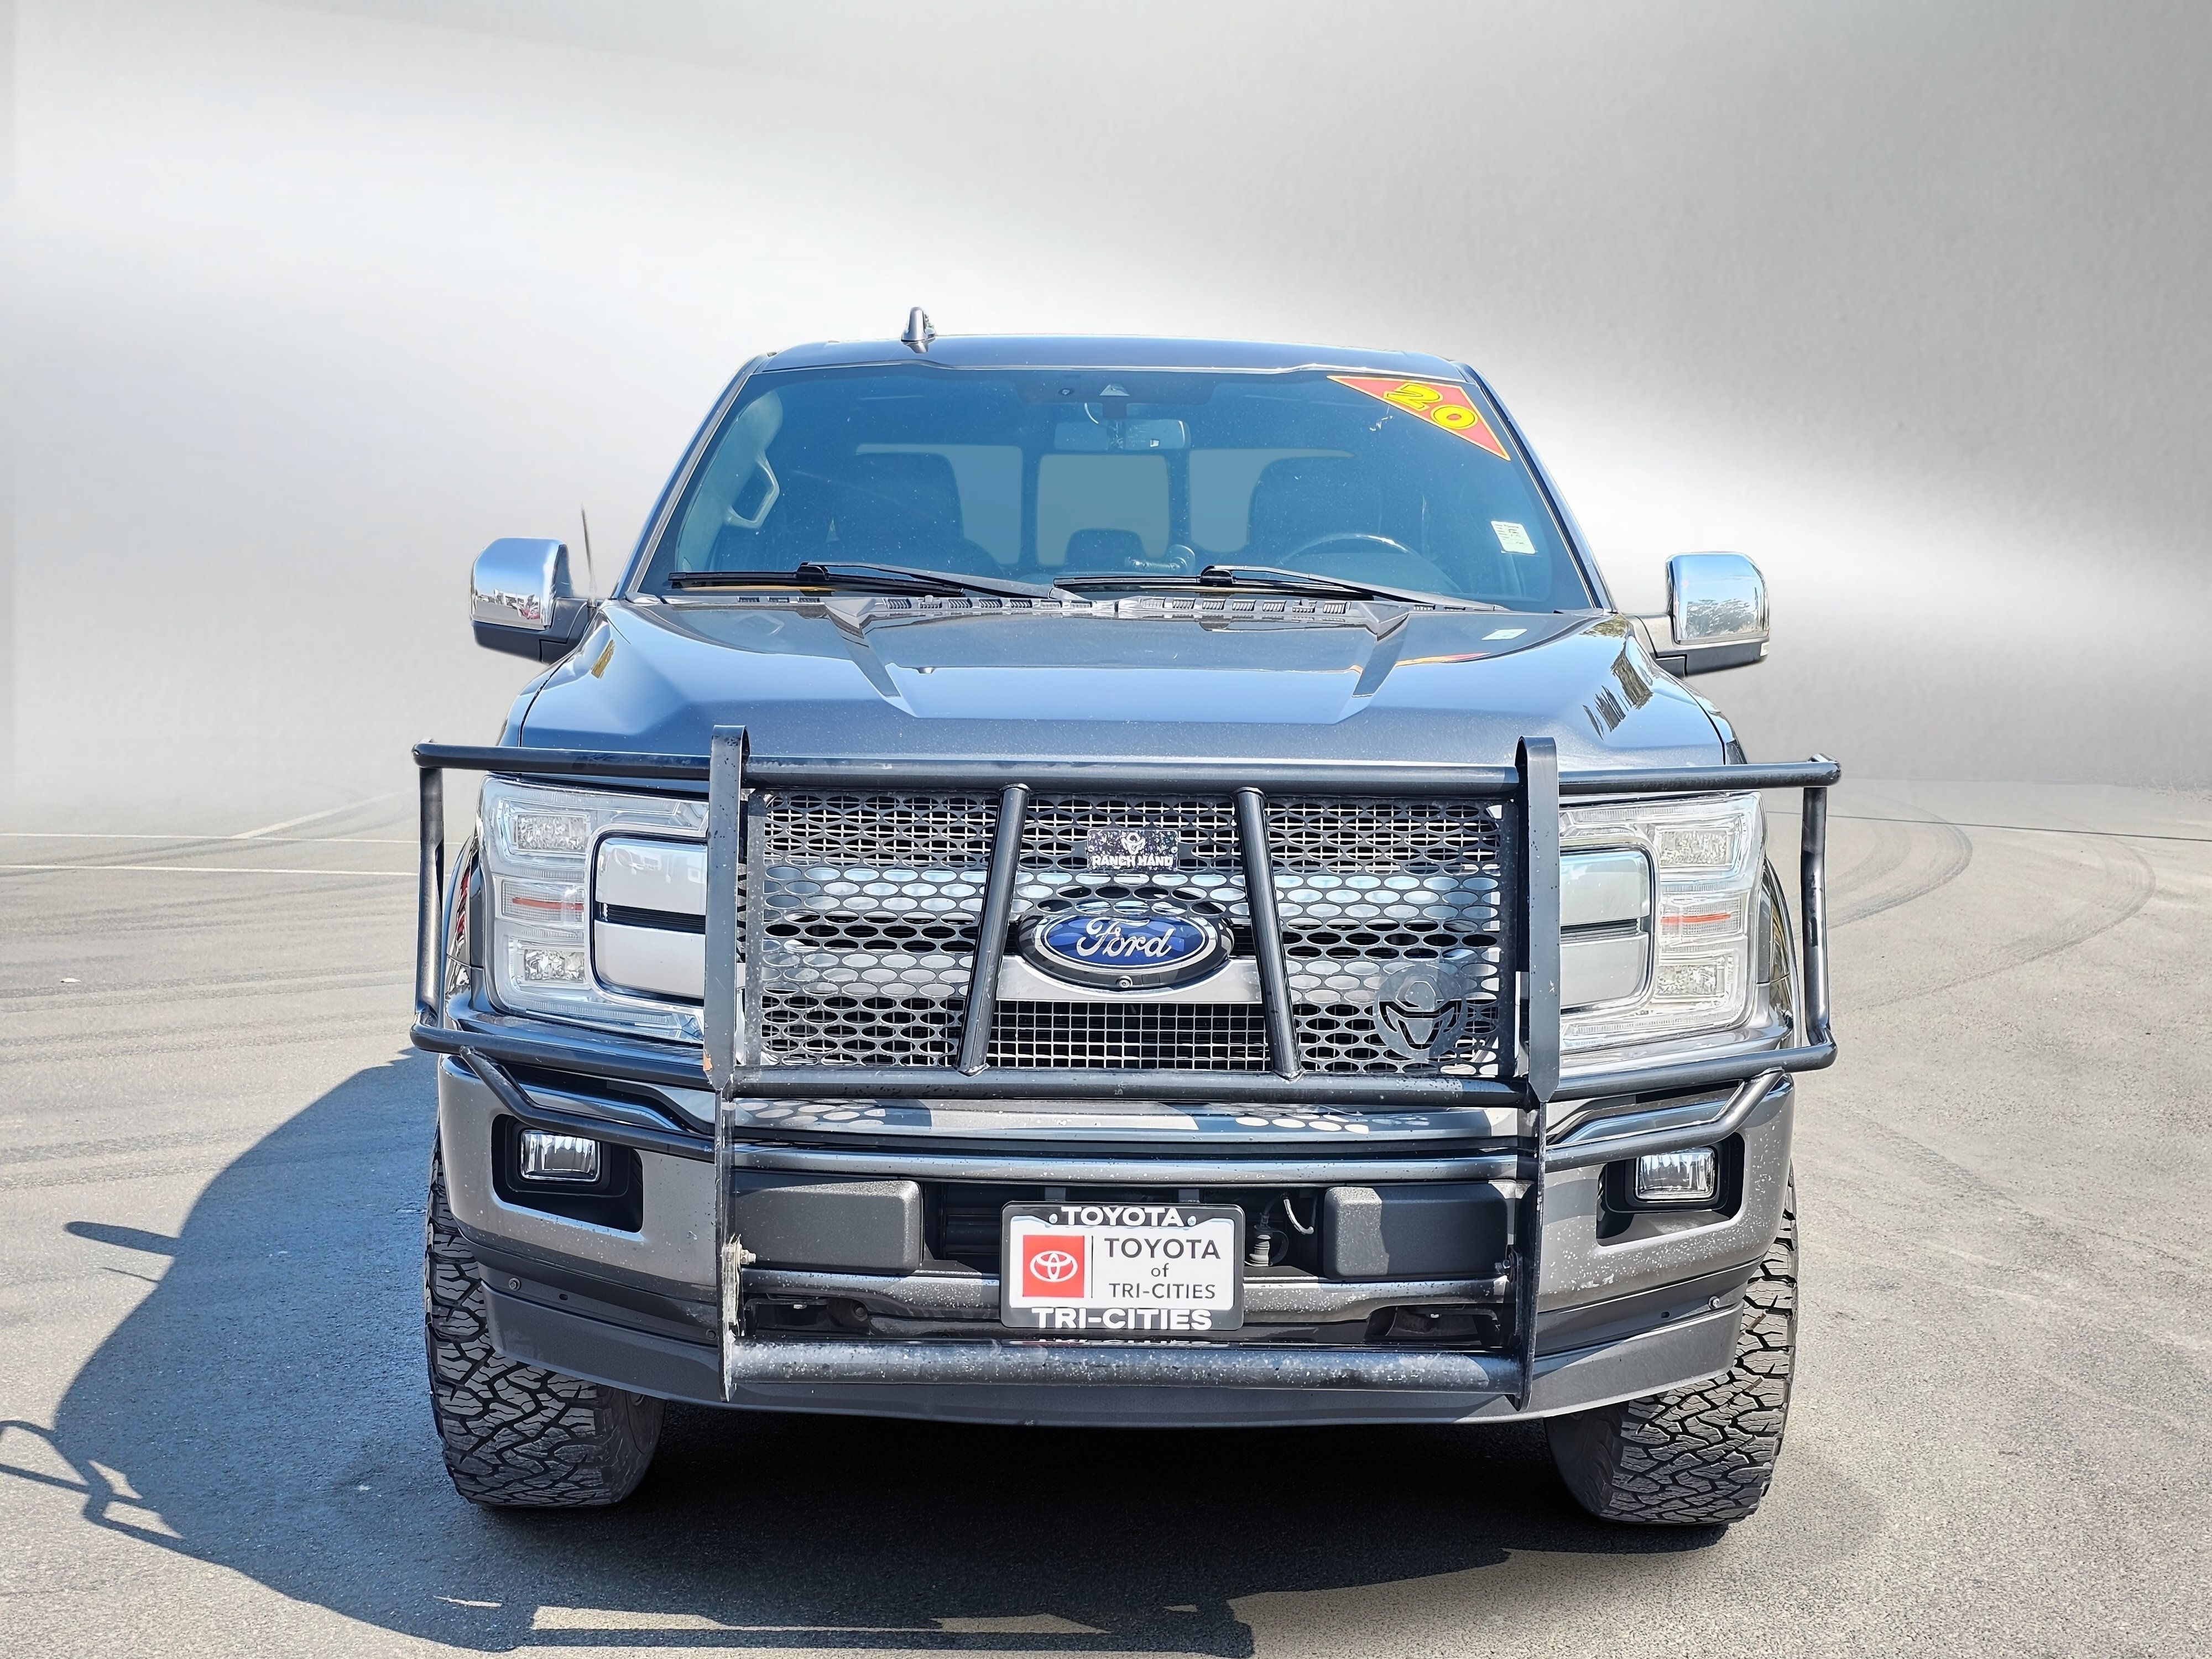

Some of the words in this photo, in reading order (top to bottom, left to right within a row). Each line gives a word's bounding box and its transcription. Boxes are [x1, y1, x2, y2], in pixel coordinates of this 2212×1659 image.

[1385, 383, 1478, 429] 20
[1092, 855, 1135, 867] RANCH
[1138, 854, 1173, 867] HAND
[1077, 916, 1176, 957] Ford
[1061, 1206, 1184, 1227] TOYOTA
[1104, 1238, 1220, 1259] TOYOTA
[1151, 1263, 1169, 1277] of
[1109, 1282, 1215, 1300] TRI-CITIES
[1031, 1307, 1213, 1330] TRI-CITIES
